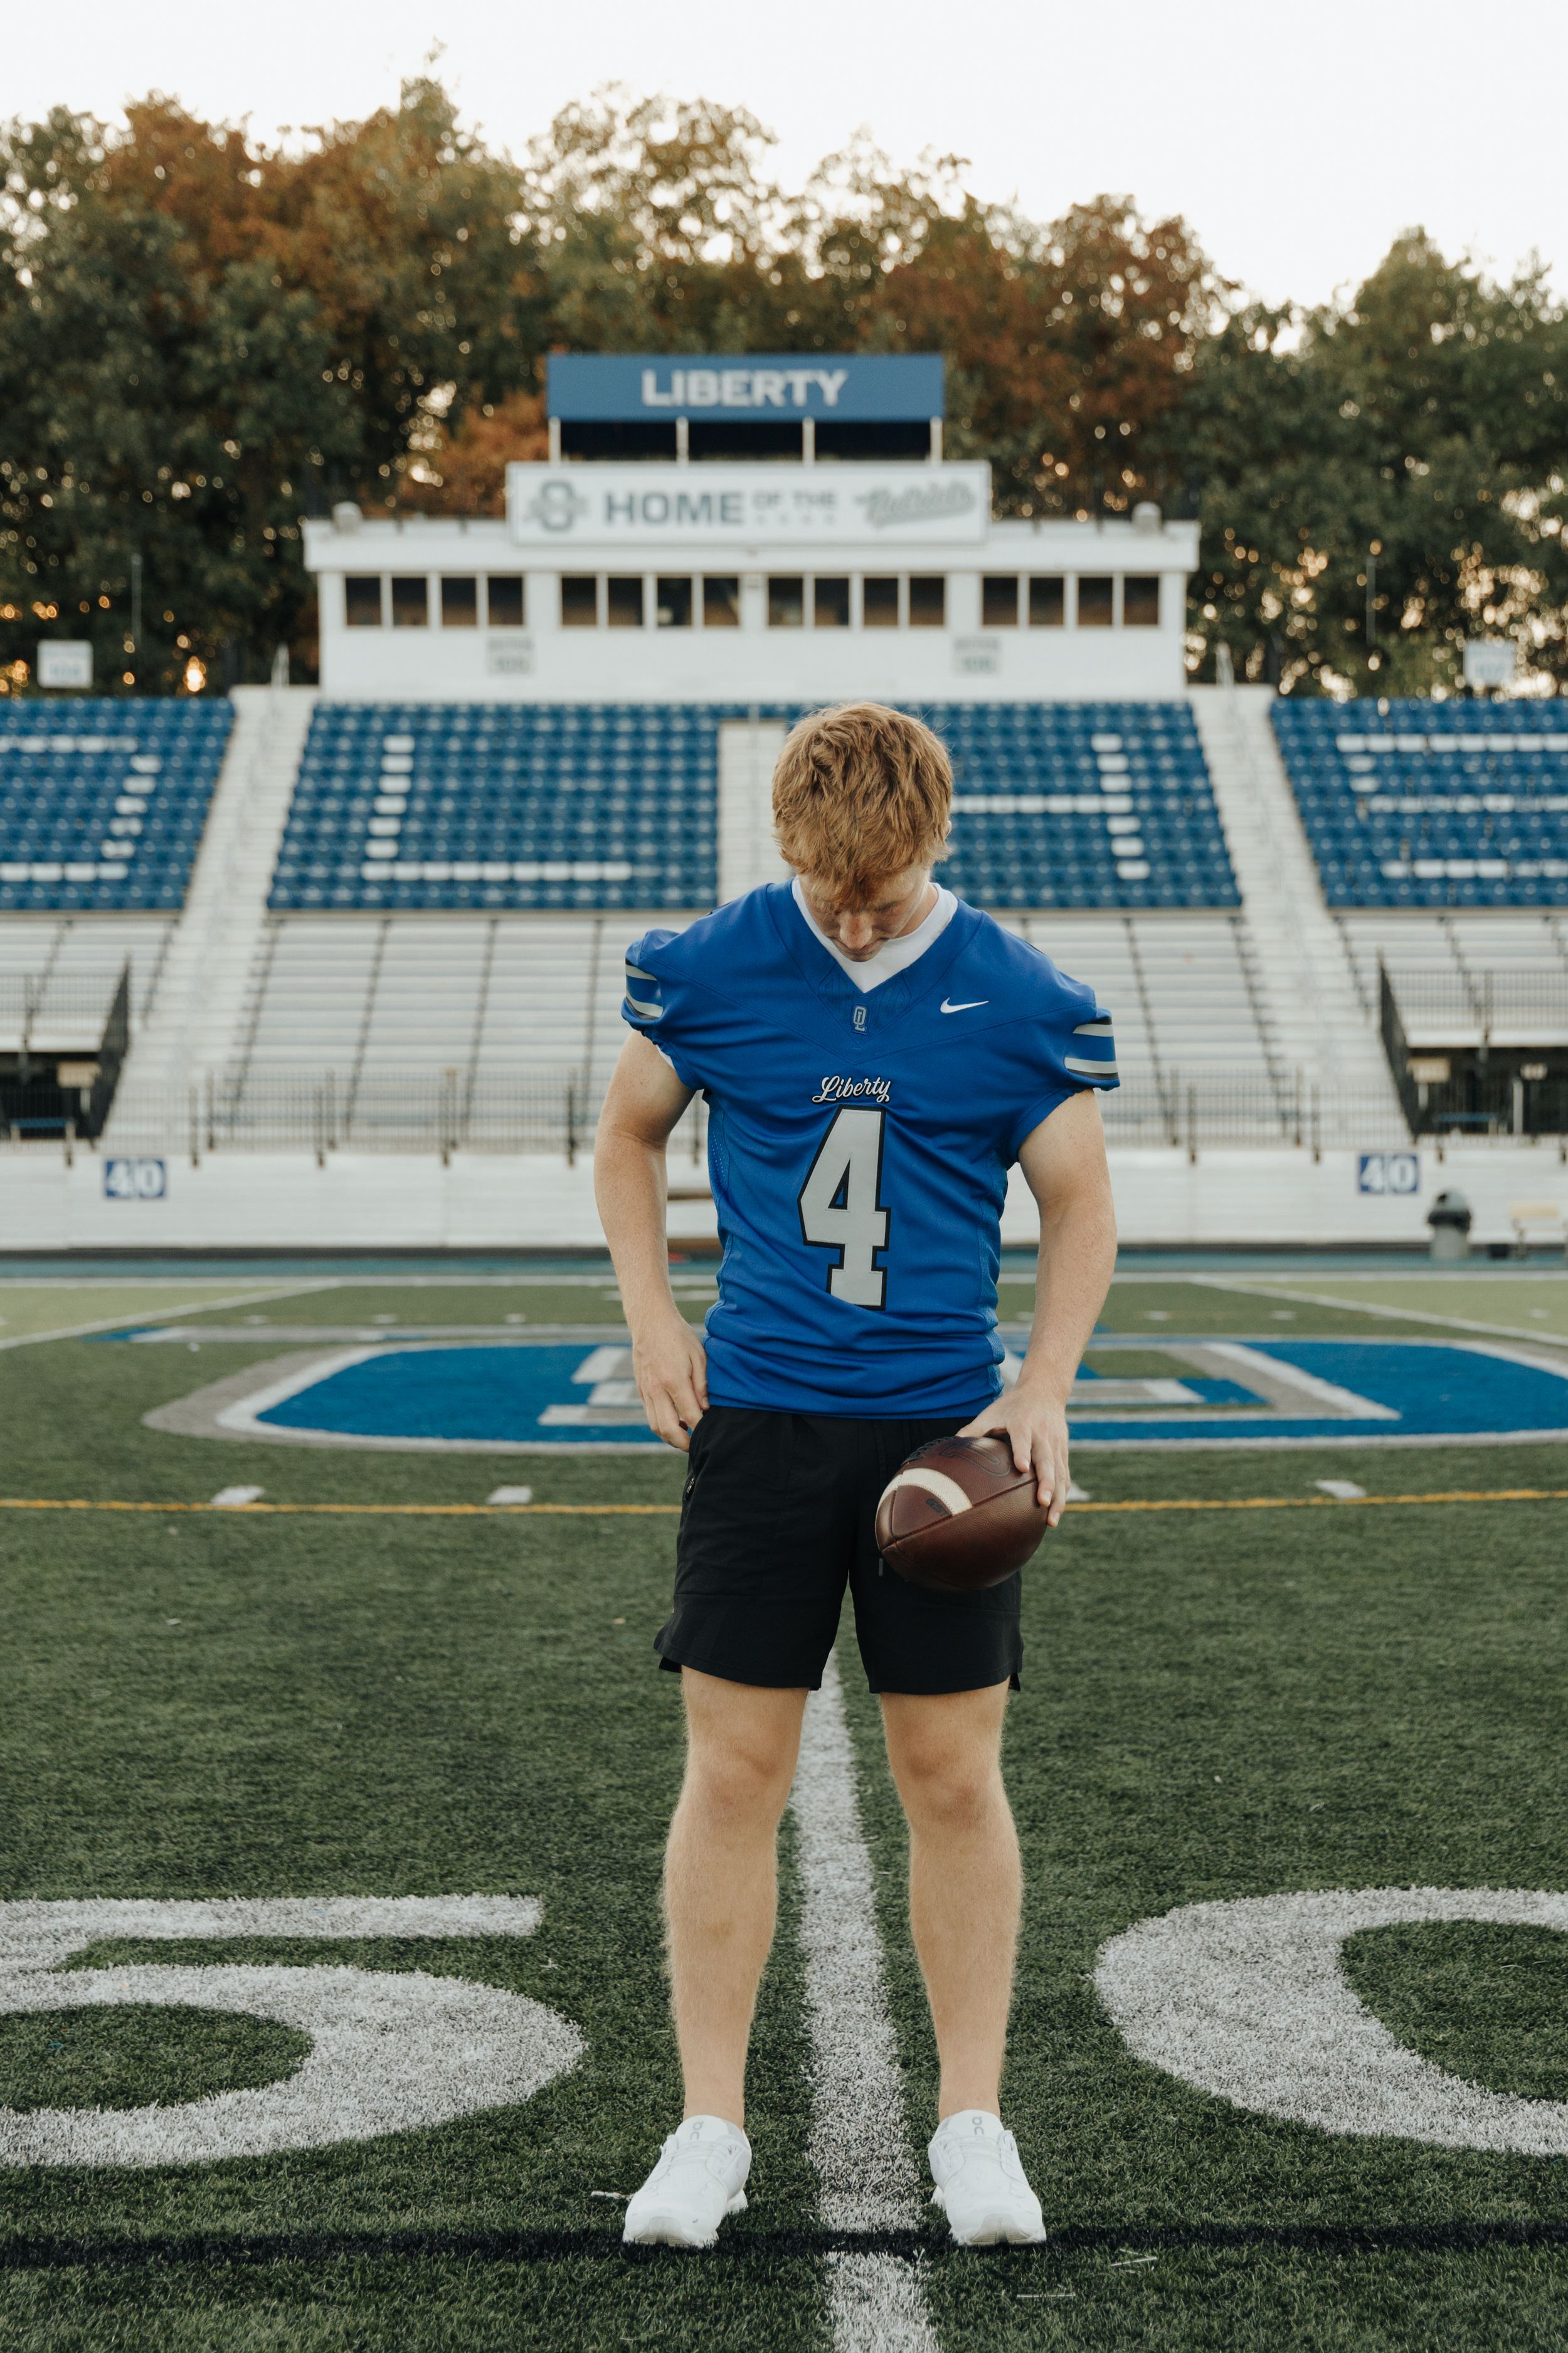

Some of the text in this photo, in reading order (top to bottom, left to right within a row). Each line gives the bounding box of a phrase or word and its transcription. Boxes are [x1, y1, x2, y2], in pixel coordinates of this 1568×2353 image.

[642, 369, 848, 407] LIBERTY
[605, 491, 745, 526] HOME
[811, 1075, 891, 1103] Liberty
[107, 1161, 163, 1198] 40
[1360, 1155, 1417, 1193] 40
[797, 1103, 891, 1311] 4
